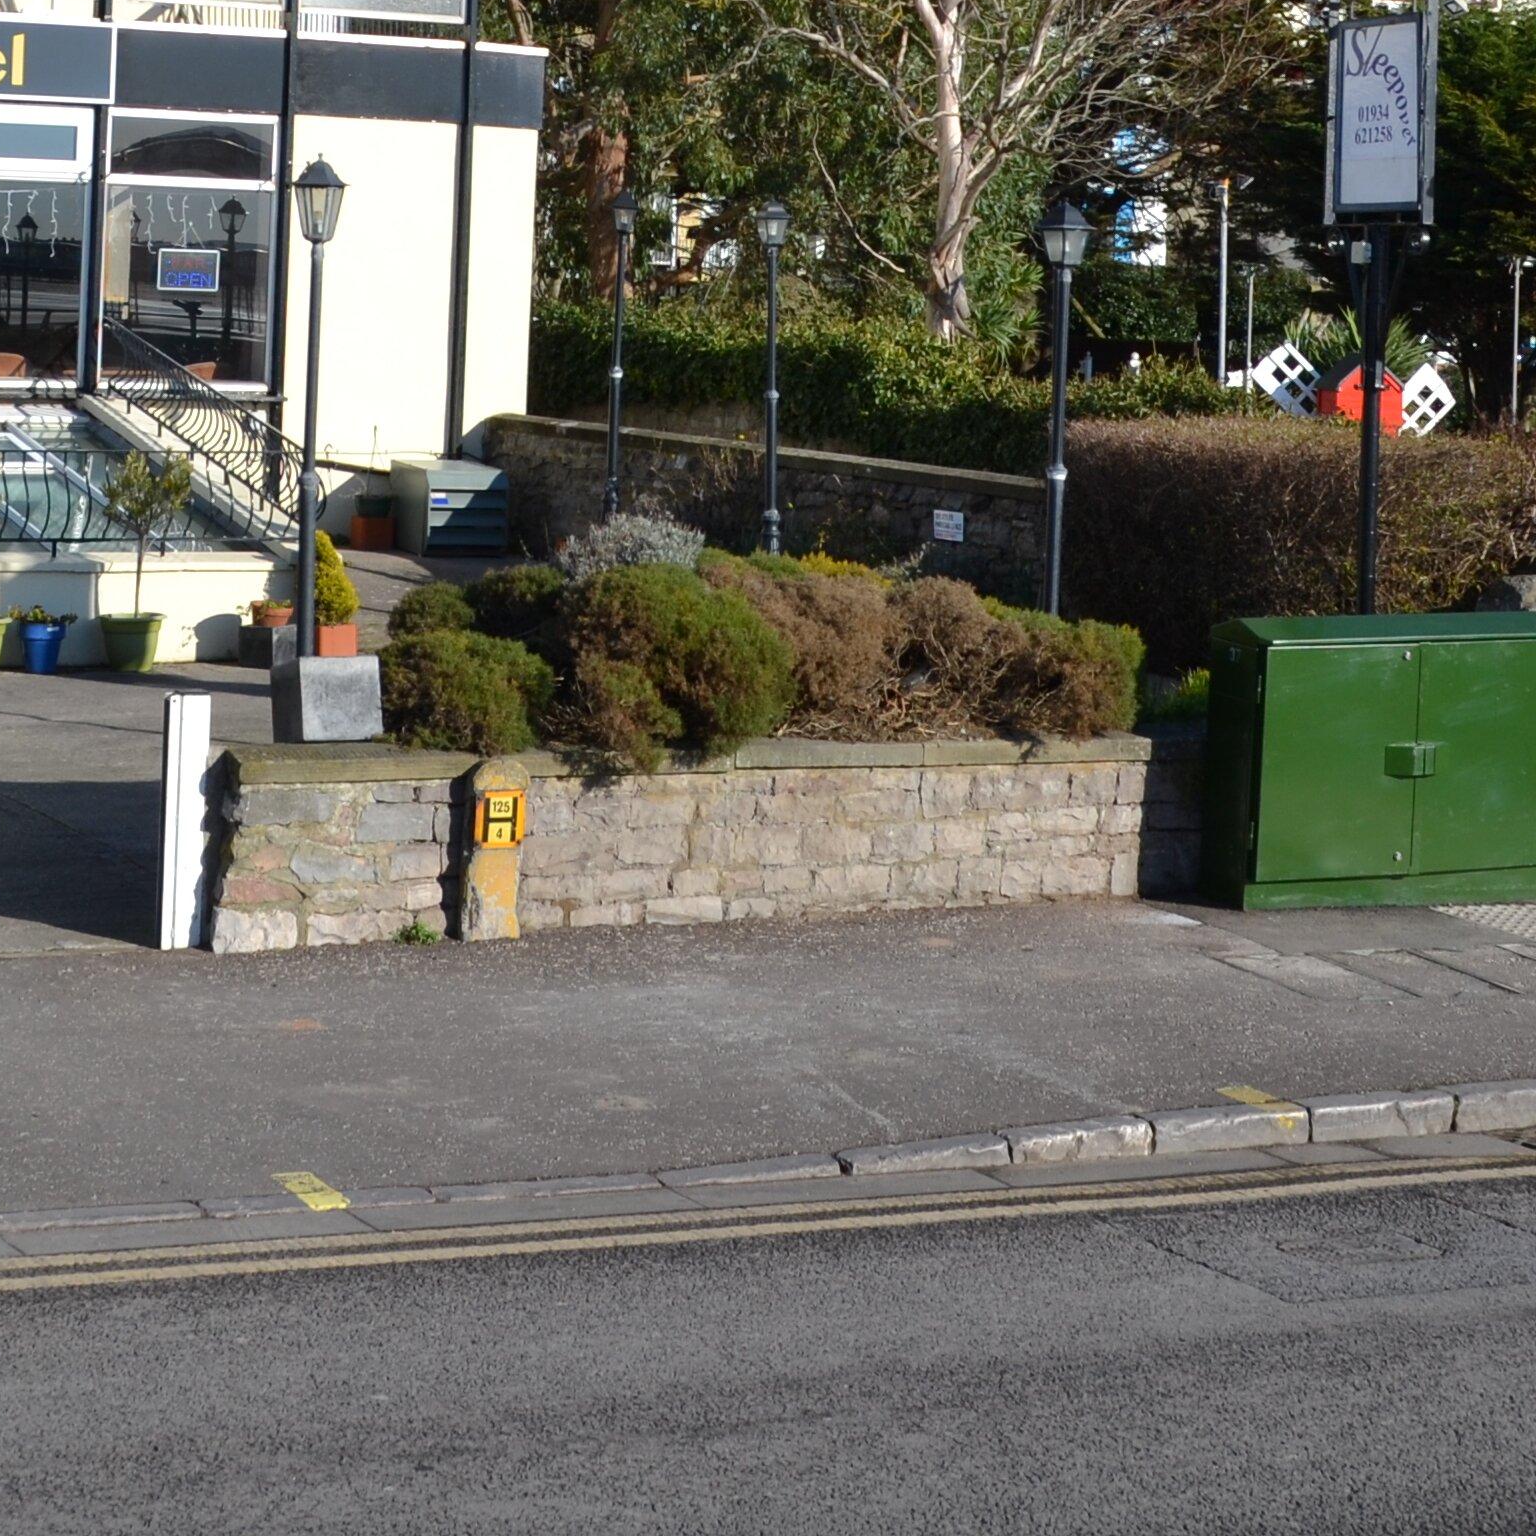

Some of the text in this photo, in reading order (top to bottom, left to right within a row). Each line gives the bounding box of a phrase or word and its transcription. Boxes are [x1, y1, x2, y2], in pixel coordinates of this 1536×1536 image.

[1345, 24, 1417, 146] Sleepover
[1357, 104, 1390, 123] 01934
[1354, 125, 1393, 145] 621258
[165, 271, 213, 288] OPEN
[492, 800, 511, 814] 125
[495, 828, 503, 839] 4
